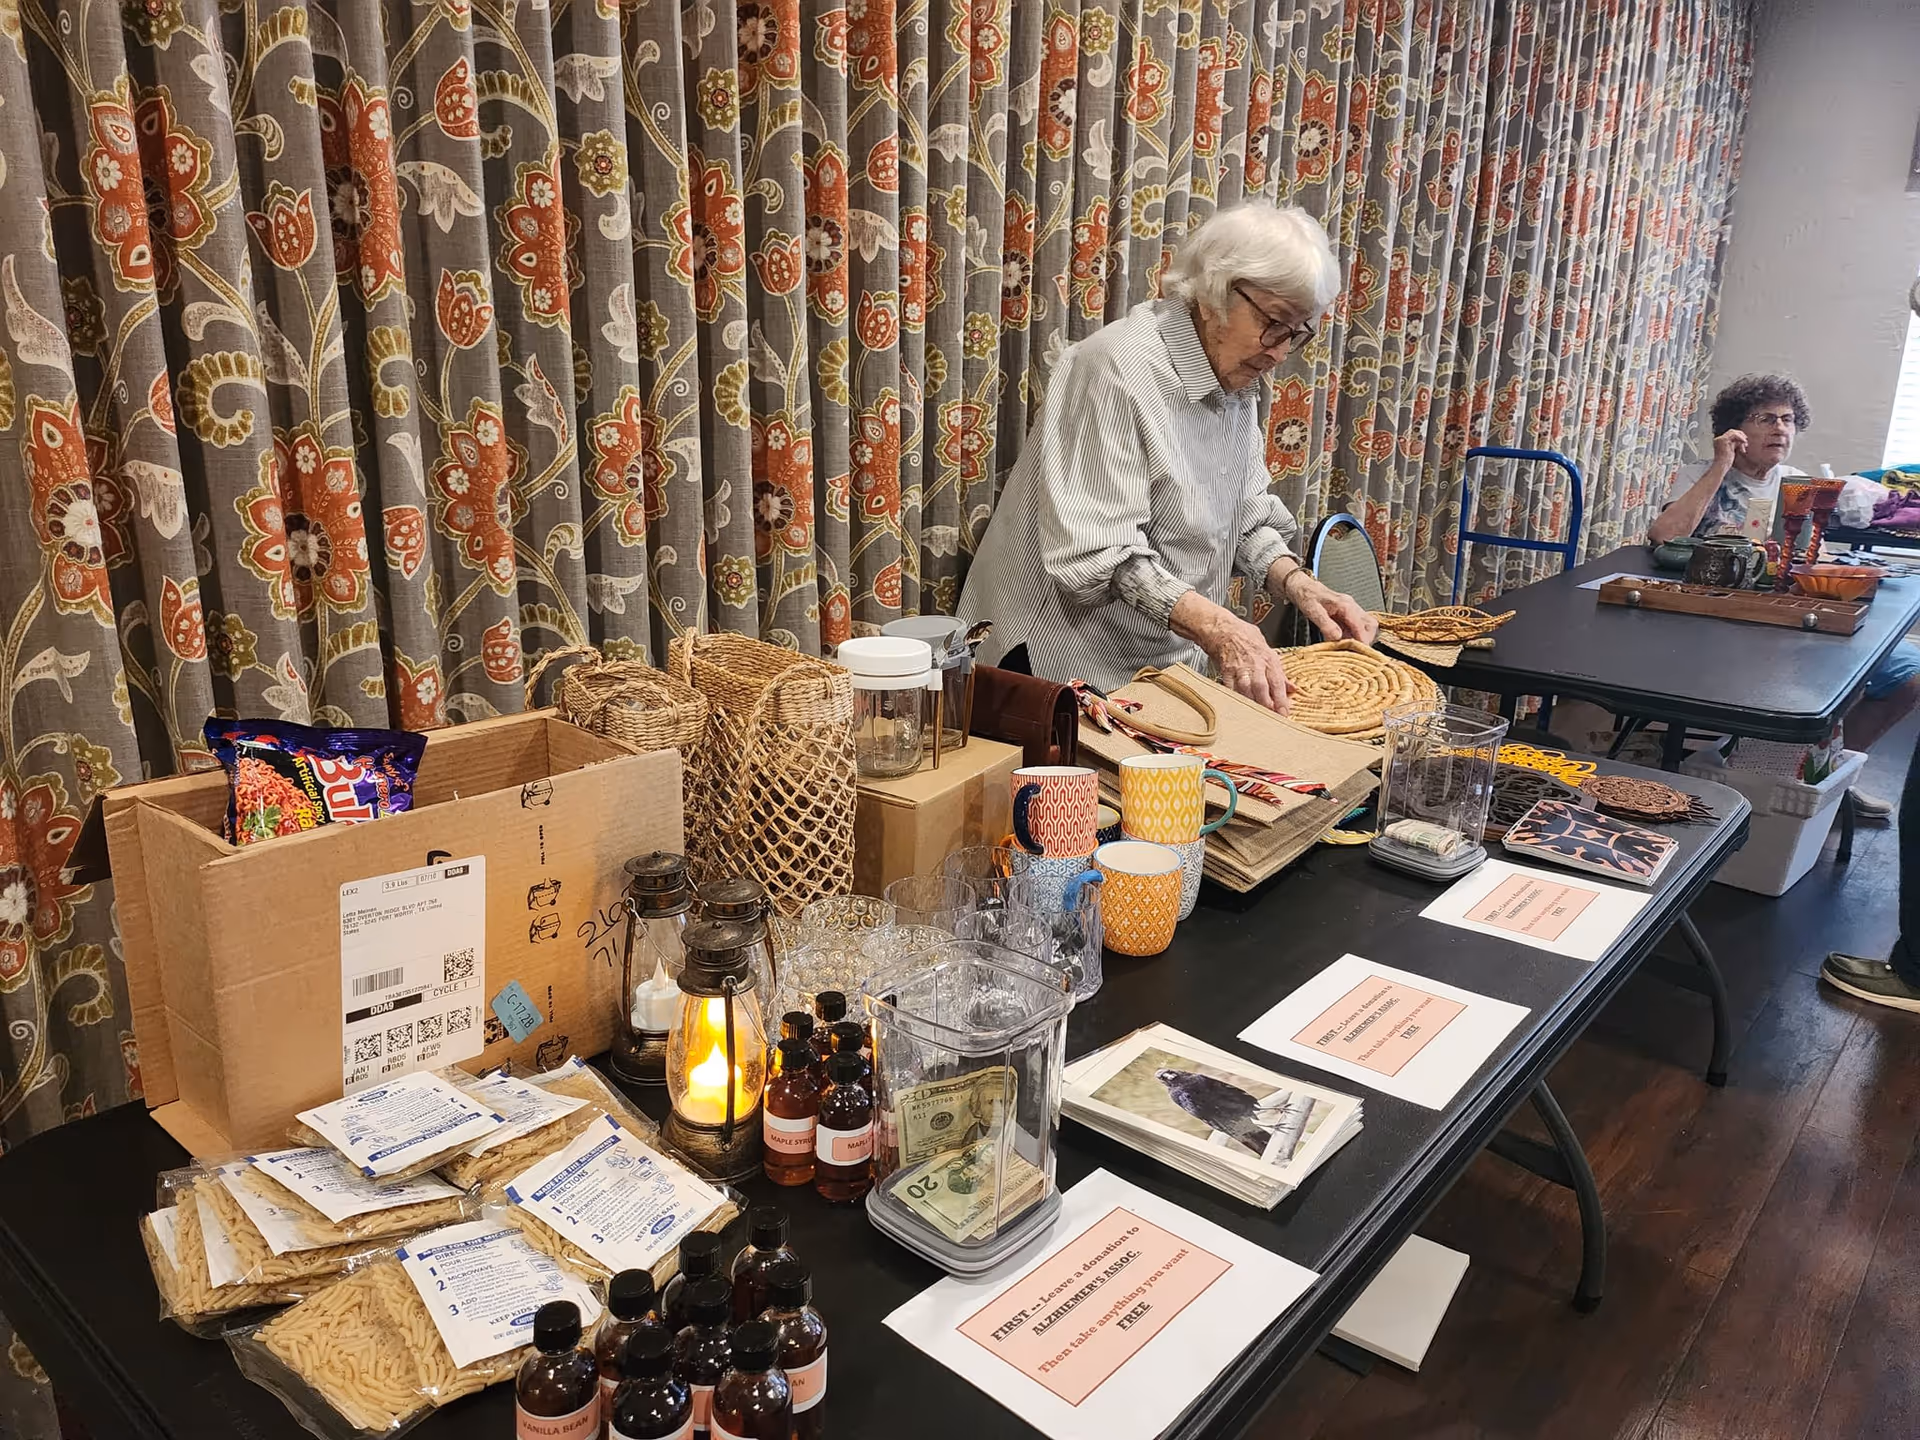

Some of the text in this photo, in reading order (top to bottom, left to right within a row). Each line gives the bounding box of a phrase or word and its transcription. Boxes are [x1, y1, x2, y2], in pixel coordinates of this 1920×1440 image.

[292, 757, 326, 823] Artificial Spicy
[307, 755, 374, 824] Bul
[342, 888, 359, 896] LEX2
[385, 882, 396, 890] 3.9
[433, 984, 459, 997] CYCLE
[370, 1002, 394, 1016] DDA9
[1316, 1028, 1338, 1047] FIRST
[1341, 1011, 1360, 1029] Leave
[1361, 989, 1386, 1010] donation
[1357, 996, 1434, 1062] Then take anything you want
[1400, 1024, 1422, 1040] FREE
[352, 1065, 370, 1075] JAN1
[770, 1134, 793, 1146] MAPLE
[294, 1172, 304, 1180] 2
[535, 1136, 616, 1197] MADE FOR THE MICROWAVE
[549, 1169, 589, 1200] DIRECTIONS
[906, 1174, 939, 1200] 20
[552, 1194, 576, 1214] 1 POUR
[566, 1188, 607, 1226] 2 MICROWAVE
[591, 1222, 614, 1244] 3 ADD
[634, 1201, 681, 1243] KEEP KIDS SAFE!
[434, 1244, 488, 1261] DIRECTIONS
[429, 1259, 462, 1277] 1 POUR
[436, 1264, 494, 1292] 2 MICROWAVE
[990, 1310, 1030, 1342] FIRST
[1039, 1275, 1074, 1304] Leave
[1074, 1270, 1083, 1278] a
[1082, 1232, 1125, 1272] donation
[1126, 1225, 1140, 1237] to
[1031, 1248, 1142, 1338] ALZHIEMER'S ASSOC.
[448, 1296, 478, 1316] 3 ADD
[488, 1313, 510, 1326] KEEP
[511, 1308, 534, 1318] KIDS
[1038, 1248, 1190, 1375] Then take anything you want
[1115, 1300, 1153, 1332] FREE
[522, 1415, 590, 1437] VANILLA BEAN
